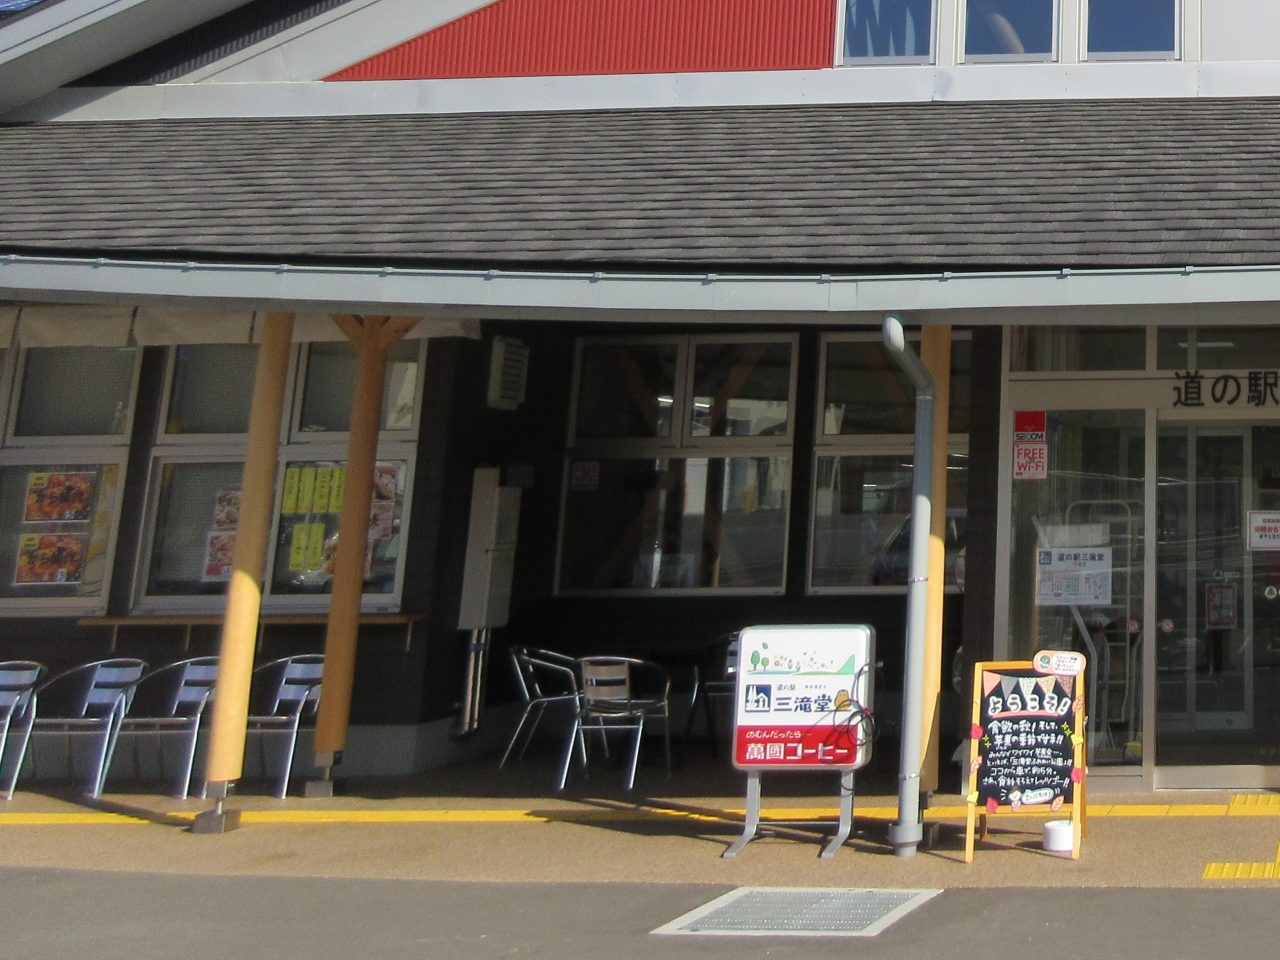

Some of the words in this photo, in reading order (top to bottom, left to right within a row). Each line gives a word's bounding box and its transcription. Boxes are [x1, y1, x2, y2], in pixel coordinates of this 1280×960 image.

[1172, 370, 1280, 407] 道の駅
[1015, 432, 1044, 441] SECOM
[1016, 448, 1045, 459] FREE
[1017, 461, 1045, 472] Wi-Fi
[774, 693, 833, 713] 三滝堂
[745, 742, 848, 760] 萬國コーヒー
